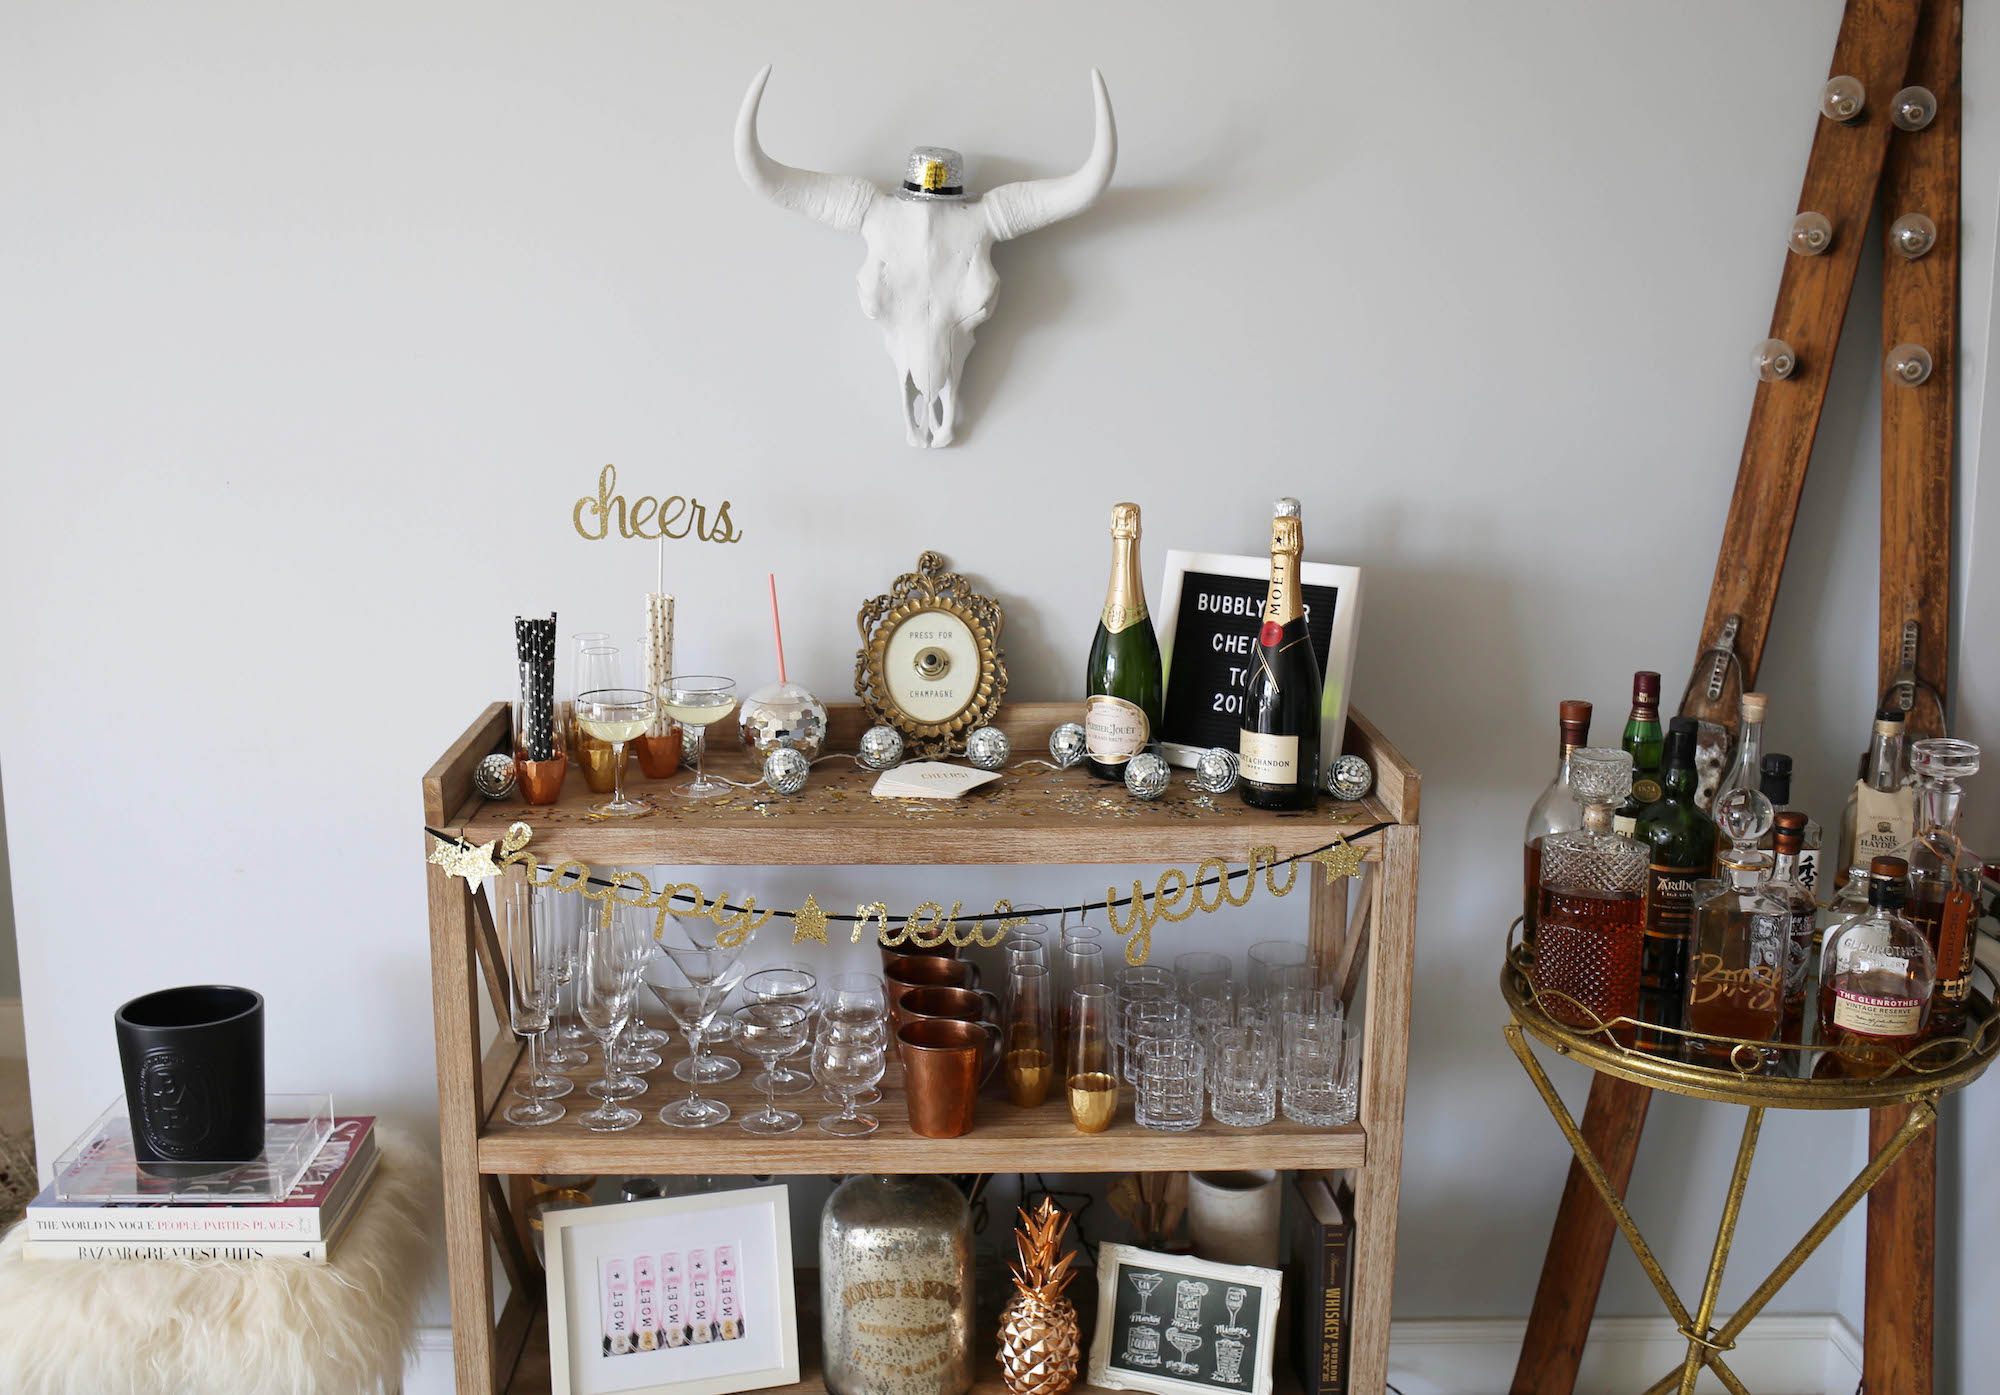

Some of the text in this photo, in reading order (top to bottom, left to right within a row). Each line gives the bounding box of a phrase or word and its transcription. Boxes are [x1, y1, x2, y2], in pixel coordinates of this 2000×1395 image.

[572, 463, 743, 544] cheers
[1197, 593, 1267, 618] BUBBLY
[909, 631, 953, 639] PRESS FOR
[909, 690, 953, 698] CHAMPAGNE
[1212, 692, 1244, 714] 201
[1253, 757, 1290, 768] CHANDON
[1871, 834, 1897, 843] BASIL
[499, 821, 1301, 966] happy new year
[1840, 990, 1919, 1007] THE GLENROTHES
[1845, 1001, 1877, 1013] VINTAGE
[36, 1220, 59, 1231] THE
[61, 1220, 102, 1231] WORLD
[103, 1220, 117, 1231] IN
[118, 1220, 155, 1231] VOGUE
[157, 1220, 200, 1231] PEOPLE
[203, 1220, 250, 1231] PARTIES
[252, 1220, 295, 1231] PLACES
[78, 1246, 264, 1260] BAZAAR GREATEST HITS
[841, 1280, 897, 1310] JONES
[901, 1280, 920, 1298] &
[1324, 1288, 1341, 1340] WHISKEY
[1214, 1324, 1251, 1337] Mimosa
[1322, 1352, 1330, 1382] RYE
[1330, 1342, 1338, 1382] BOURBON
